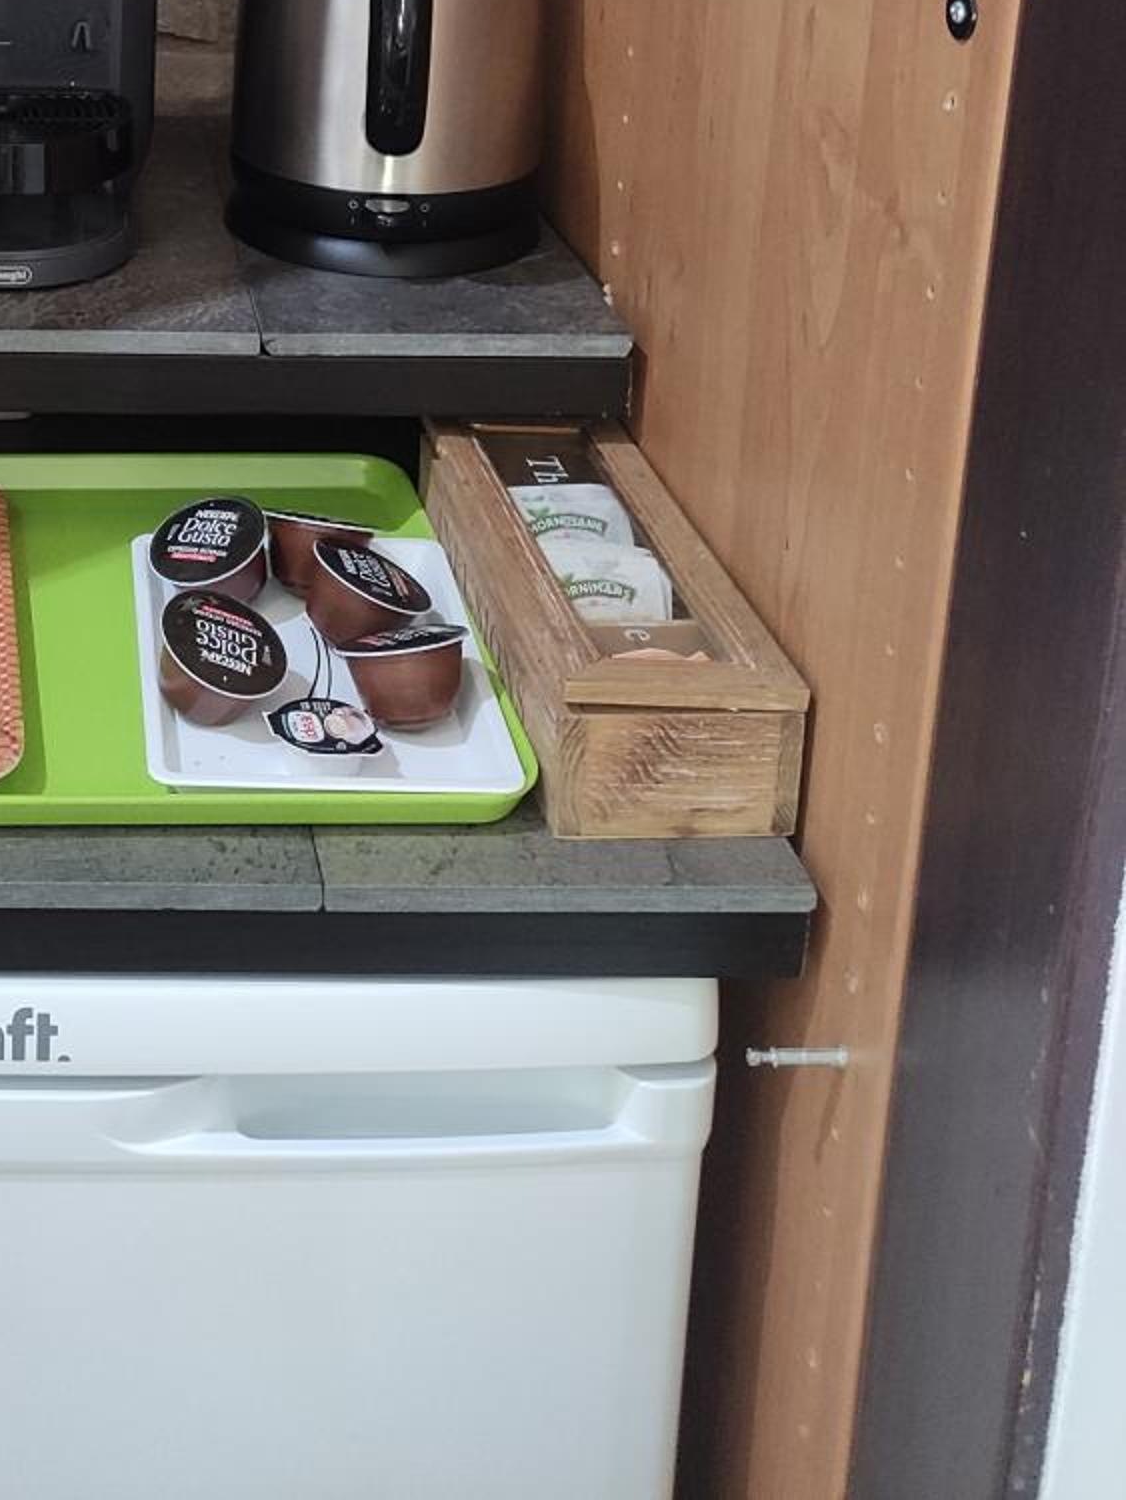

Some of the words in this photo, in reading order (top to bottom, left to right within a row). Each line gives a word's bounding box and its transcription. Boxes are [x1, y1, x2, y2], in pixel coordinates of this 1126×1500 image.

[177, 531, 232, 547] Gusto
[184, 517, 238, 536] Dolce
[195, 618, 258, 651] Gusto
[195, 631, 259, 667] Dolce
